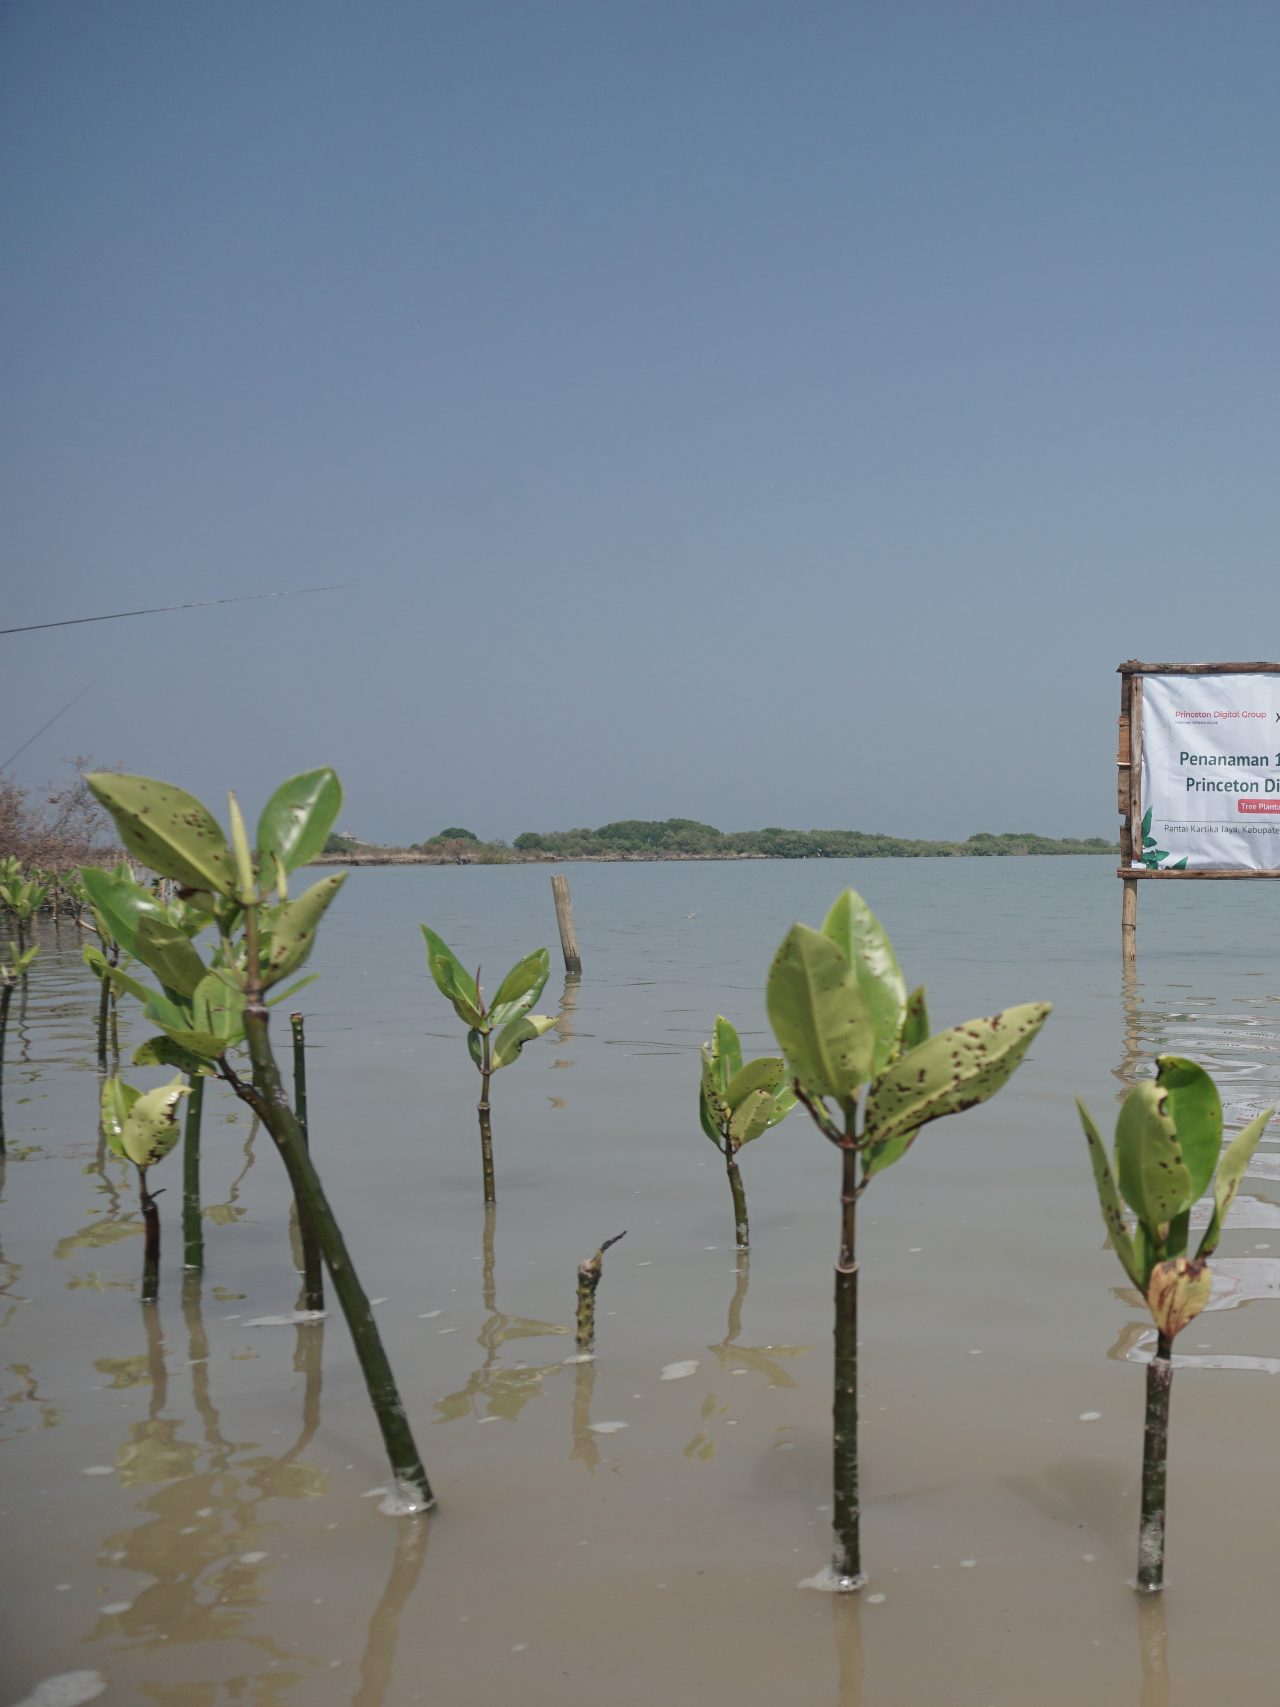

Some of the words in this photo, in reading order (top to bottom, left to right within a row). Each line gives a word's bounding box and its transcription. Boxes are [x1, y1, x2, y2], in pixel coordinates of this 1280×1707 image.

[1175, 711, 1212, 719] Princeton
[1213, 711, 1240, 720] Digital
[1242, 711, 1267, 720] Group
[1180, 751, 1269, 767] Penanaman
[1186, 777, 1259, 793] Princeton
[1241, 802, 1257, 810] Tree
[1164, 824, 1189, 833] Pantai
[1190, 824, 1219, 834] Kartika
[1221, 825, 1240, 835] Jaya,
